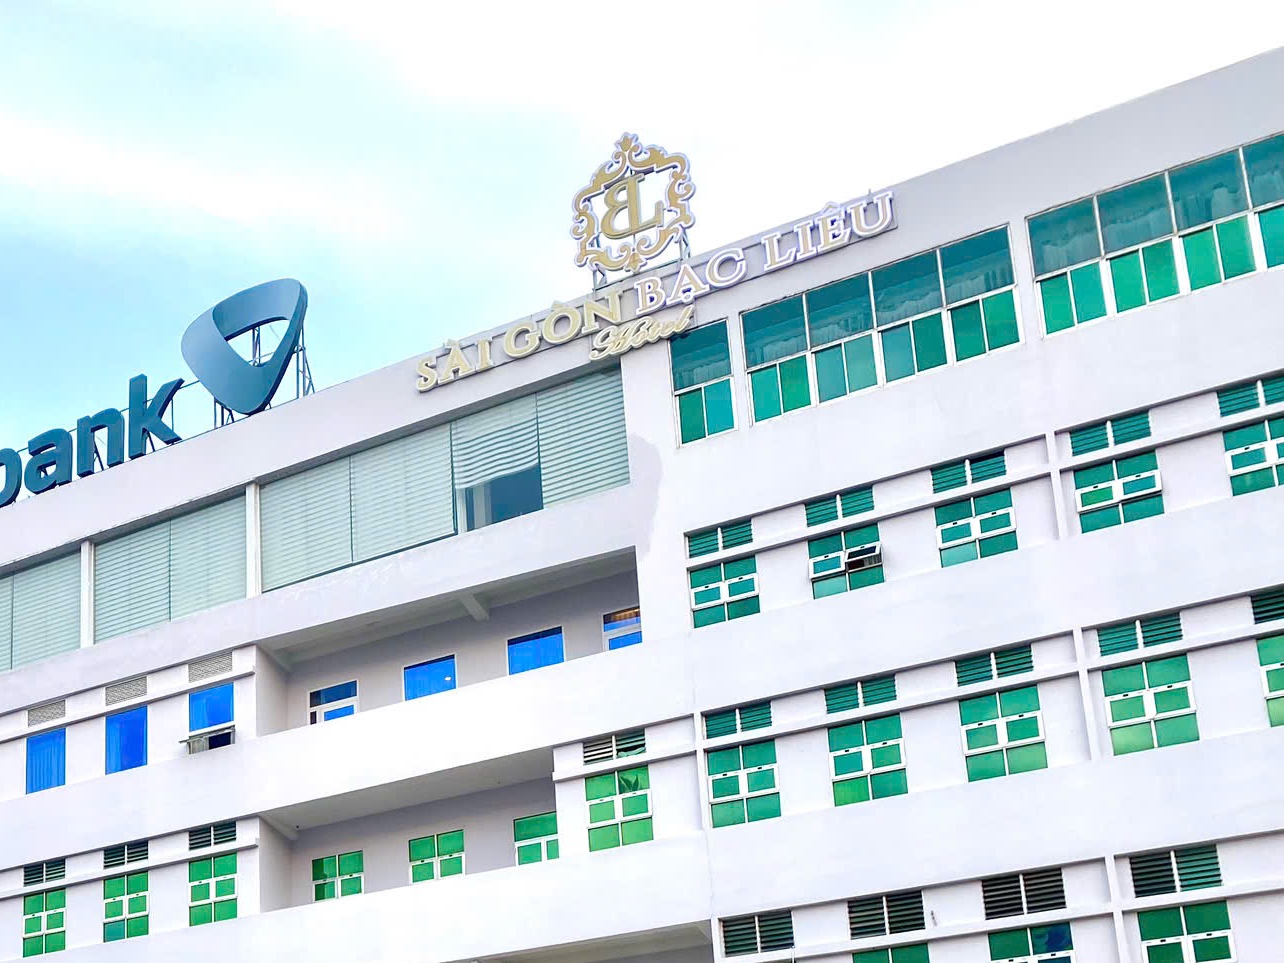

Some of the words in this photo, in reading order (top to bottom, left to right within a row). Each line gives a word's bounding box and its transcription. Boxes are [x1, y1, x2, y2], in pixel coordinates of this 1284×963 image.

[416, 337, 493, 392] SÀI
[503, 290, 622, 358] GÒN
[633, 245, 748, 317] BẠC
[761, 190, 894, 272] LIÊU
[588, 304, 696, 363] Hotel
